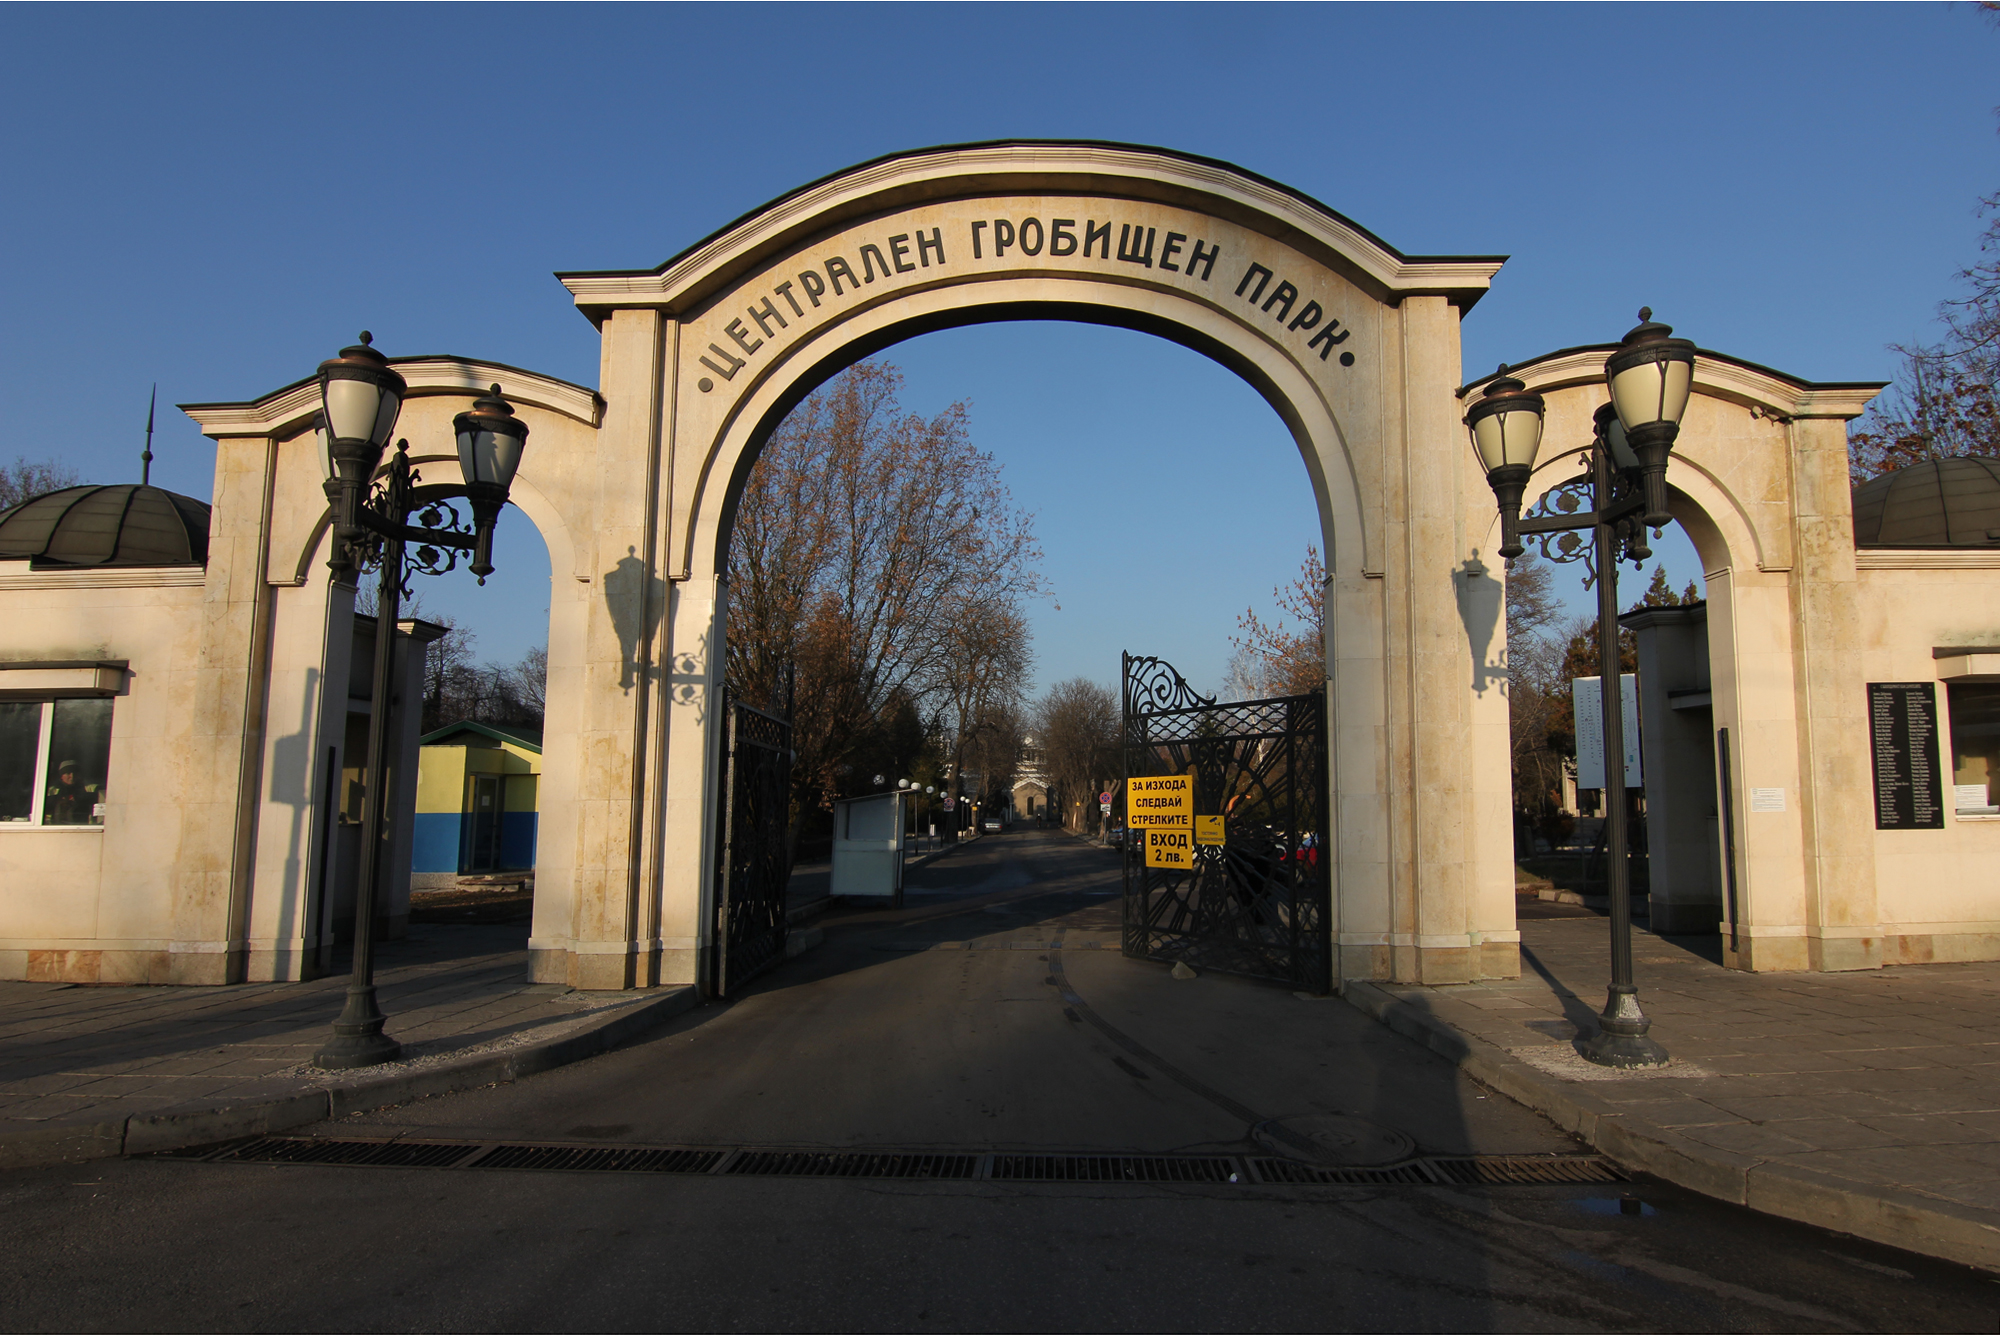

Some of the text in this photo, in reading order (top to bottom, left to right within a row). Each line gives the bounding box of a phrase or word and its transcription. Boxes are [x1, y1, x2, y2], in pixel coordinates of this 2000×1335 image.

[698, 217, 1350, 381] ЦЕНТРАЛЕН ГРОБИЩЕН ПАРК
[1132, 780, 1186, 791] ЗА ИЗХОДА
[1136, 795, 1182, 809] СЛЕДВАЙ
[1132, 815, 1188, 825] СТРЕЛКИТЕ
[1151, 834, 1188, 849] ВХОД
[1155, 849, 1162, 862] 2
